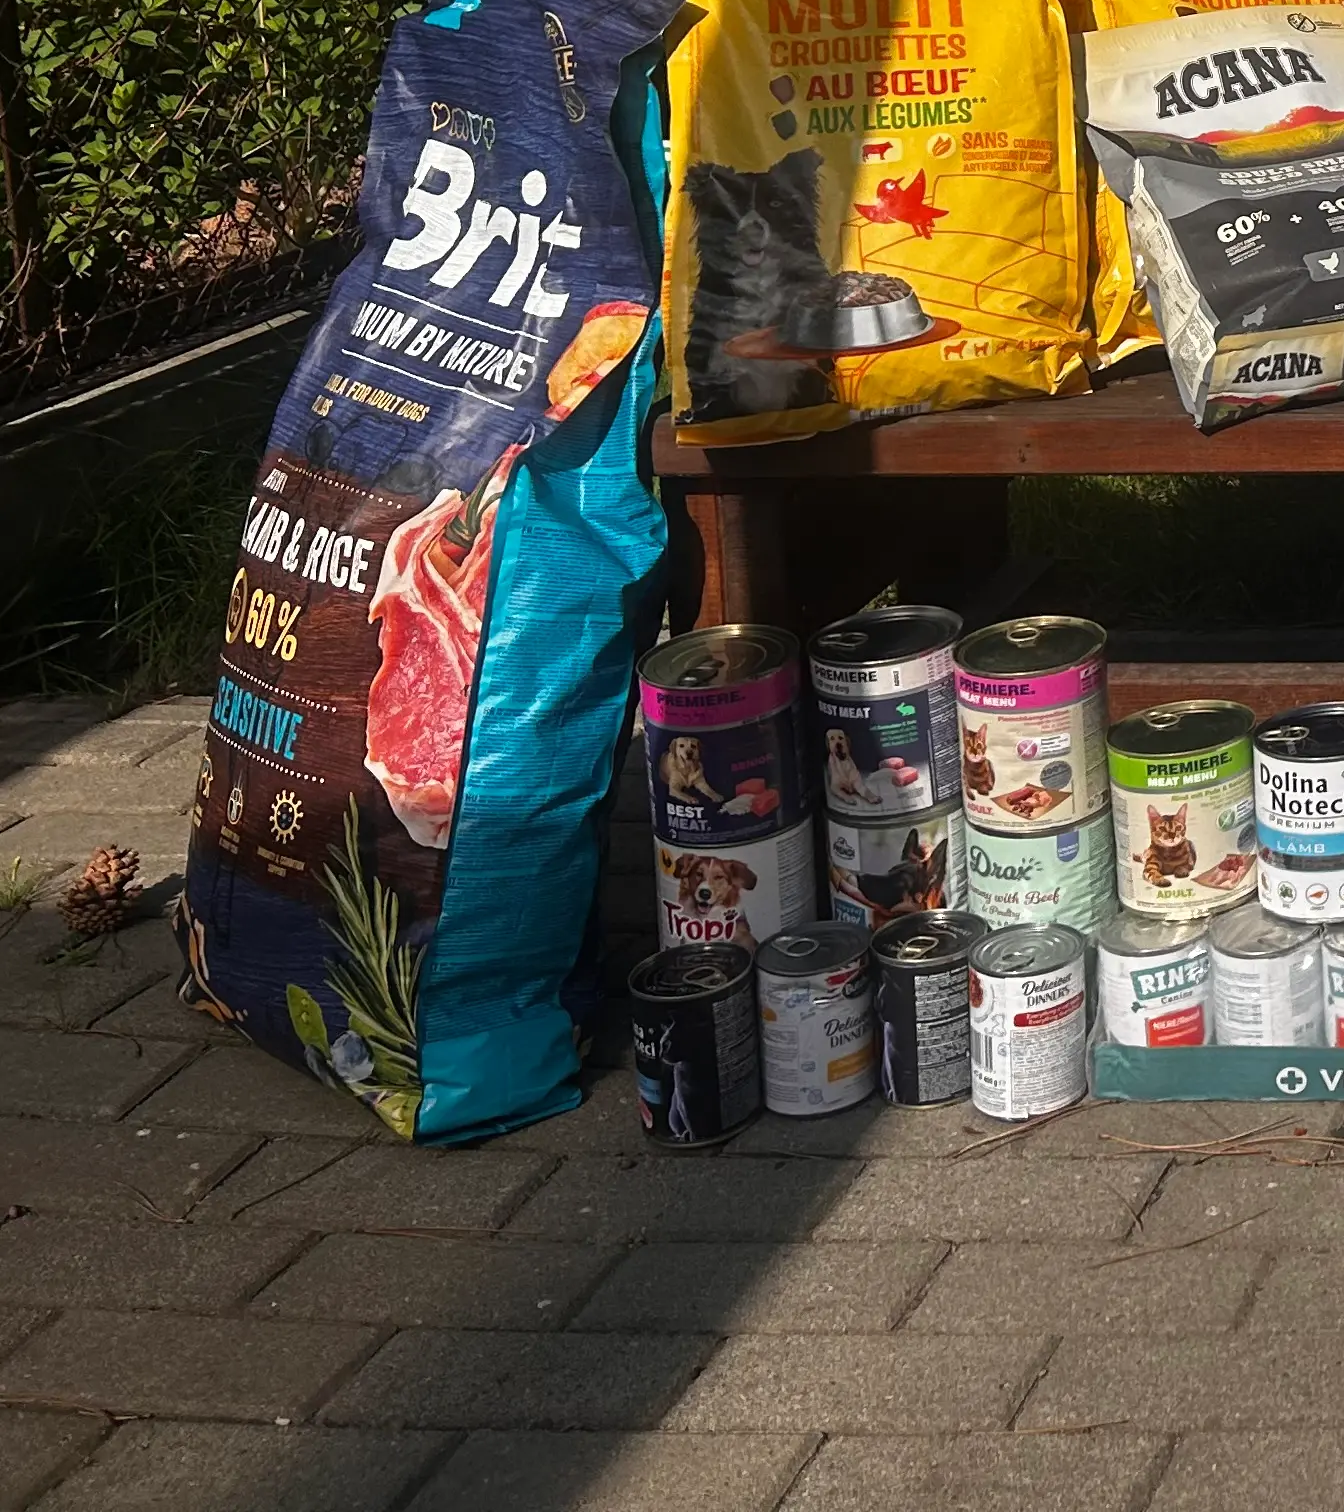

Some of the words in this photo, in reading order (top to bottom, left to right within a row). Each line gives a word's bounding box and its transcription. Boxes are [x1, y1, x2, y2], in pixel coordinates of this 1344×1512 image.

[770, 34, 967, 68] CROQUETTES
[1154, 47, 1326, 119] ACANA
[962, 132, 1008, 149] SANS
[1218, 166, 1296, 179] ADULT
[382, 138, 582, 318] Brit
[404, 324, 454, 362] BY
[444, 338, 534, 391] NATURE
[1233, 352, 1325, 384] ACANA
[213, 676, 304, 761] SENSITIVE
[1147, 776, 1179, 787] MEAT
[1183, 770, 1218, 785] MENU
[1260, 763, 1328, 793] Dolina
[667, 804, 704, 818] BEST
[1269, 815, 1335, 829] PREMIUM
[1277, 842, 1325, 853] LAMB
[663, 898, 738, 942] Tropi
